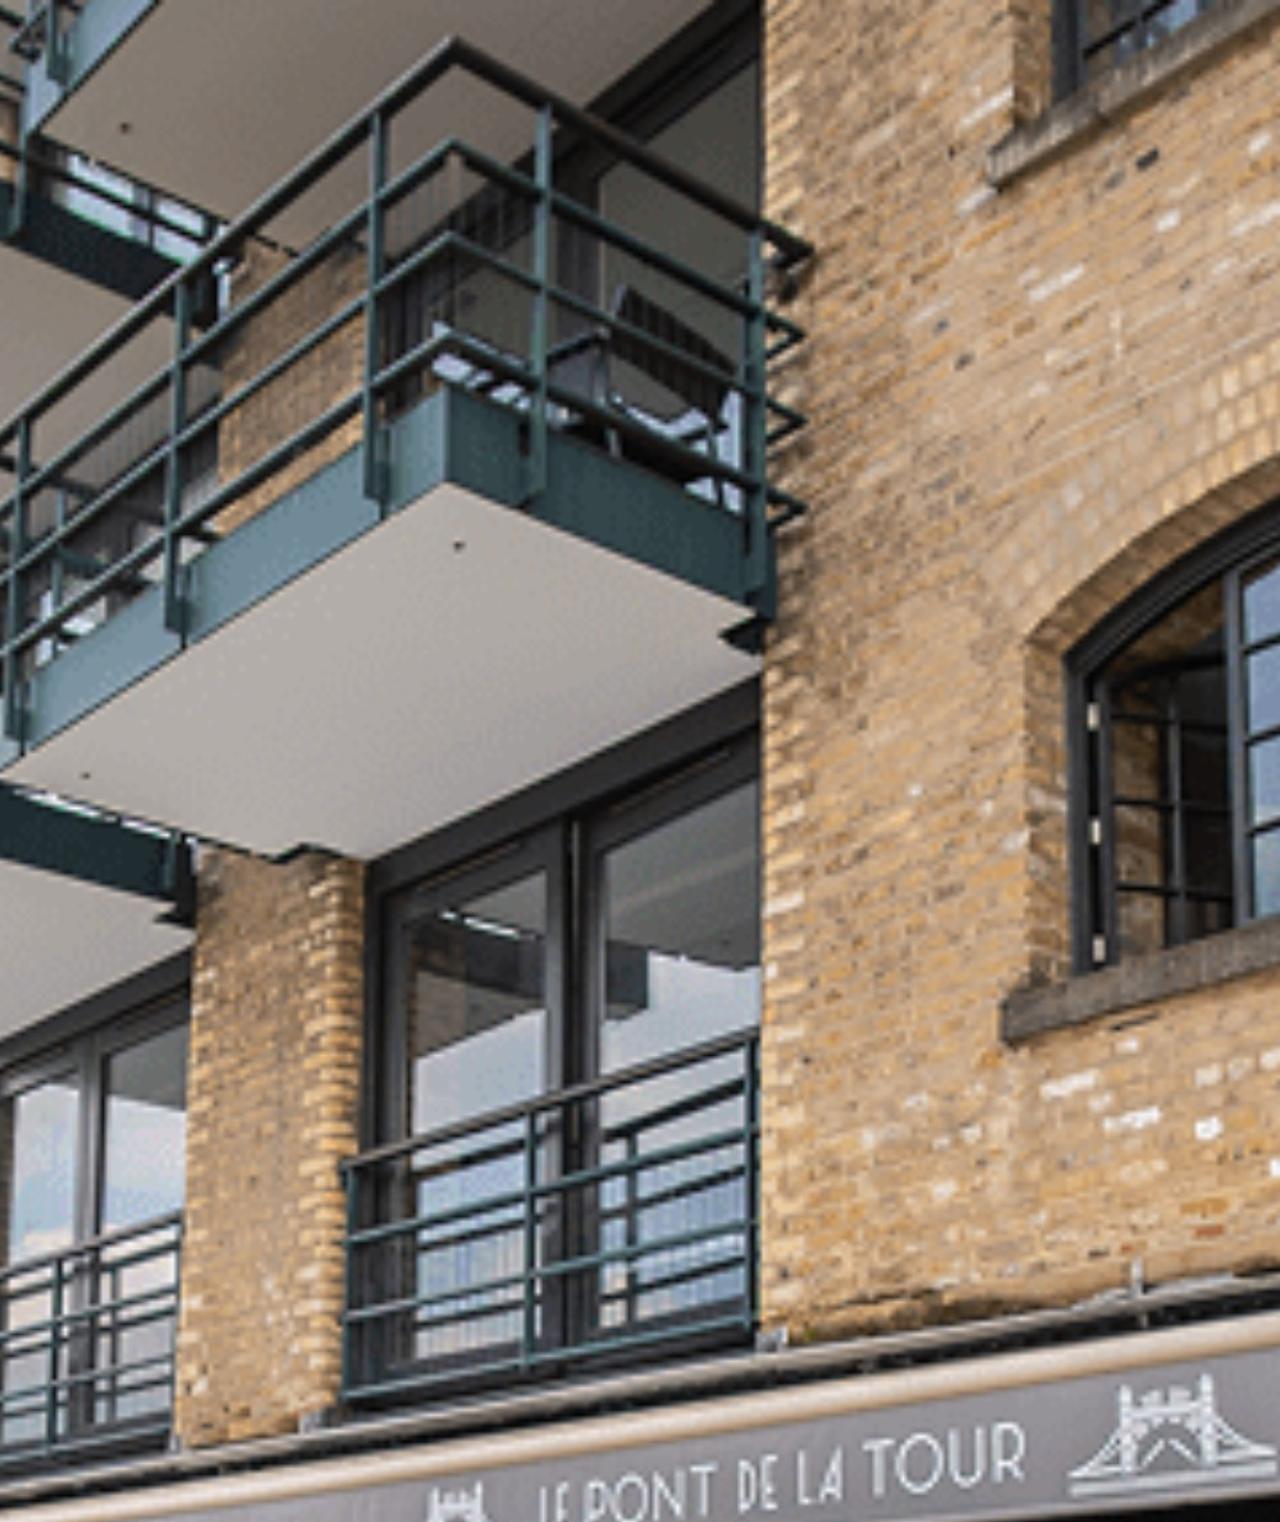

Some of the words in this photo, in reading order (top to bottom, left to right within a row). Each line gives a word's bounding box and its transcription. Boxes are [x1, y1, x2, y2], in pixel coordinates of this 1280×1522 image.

[737, 1453, 778, 1515] DE
[797, 1447, 843, 1506] LA
[861, 1421, 1026, 1497] TOUR
